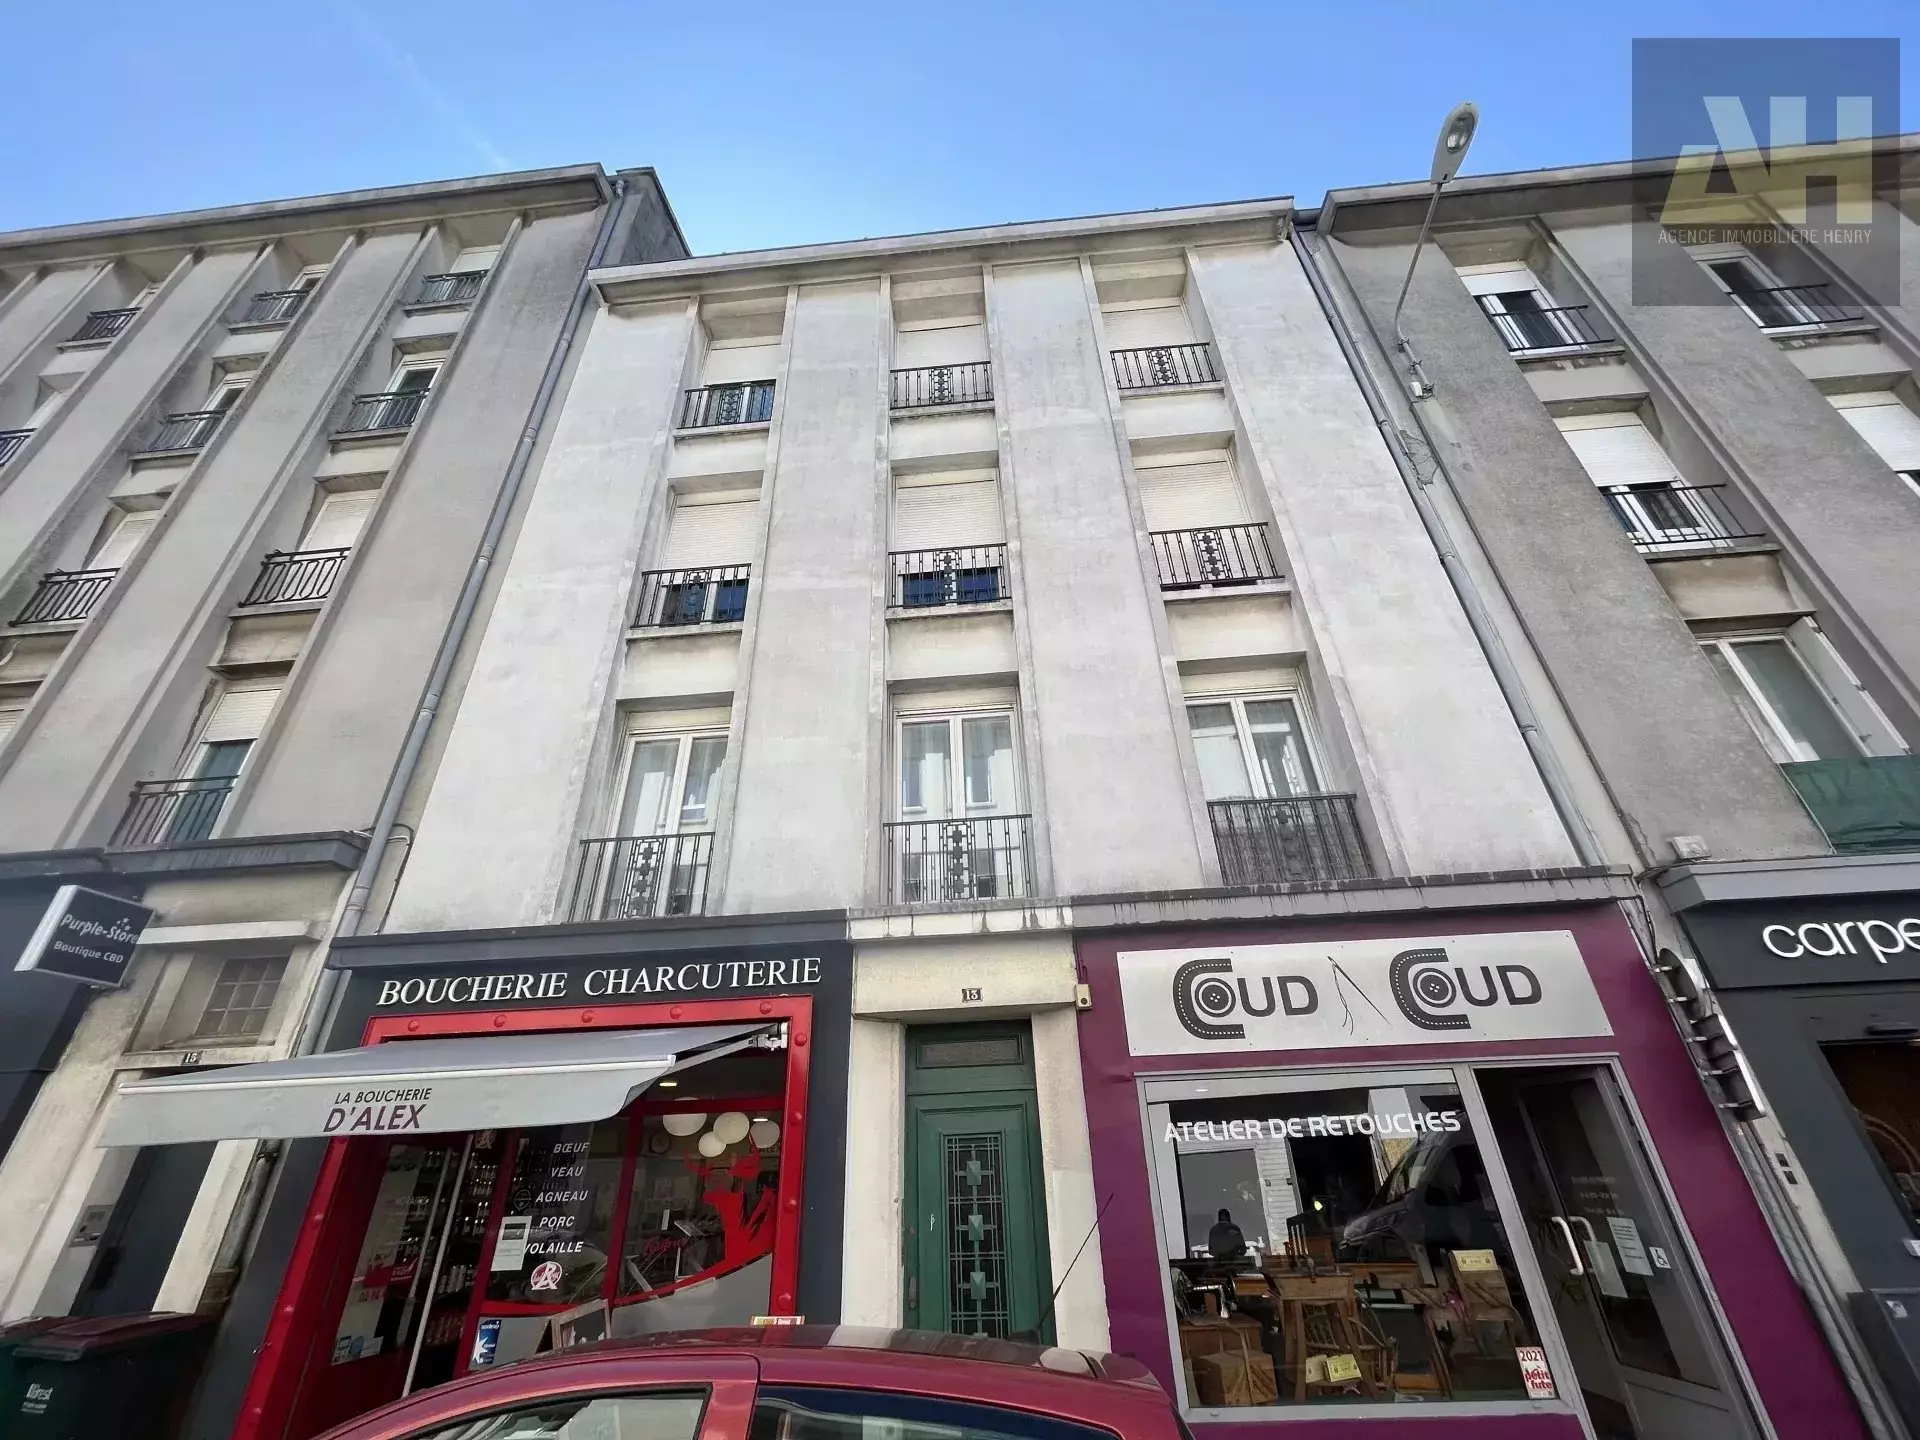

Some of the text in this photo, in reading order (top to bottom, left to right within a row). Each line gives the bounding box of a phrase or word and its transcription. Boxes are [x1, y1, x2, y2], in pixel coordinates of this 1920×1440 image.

[60, 913, 139, 944] Purple-Store
[54, 941, 124, 964] Boutique CBD
[376, 957, 822, 1006] BOUCHERIE CHARCUTERIE
[1172, 957, 1319, 1041] COUD
[1388, 947, 1543, 1031] COUD
[334, 1087, 432, 1105] LA BOUCHERIE
[322, 1103, 427, 1132] D'ALEX
[1164, 1111, 1462, 1143] ATELIER DE RETOUCHES
[551, 1166, 584, 1177] VEAU
[535, 1190, 588, 1203] AGNEAU
[539, 1216, 575, 1228] PORC
[1520, 1350, 1544, 1361] 2021
